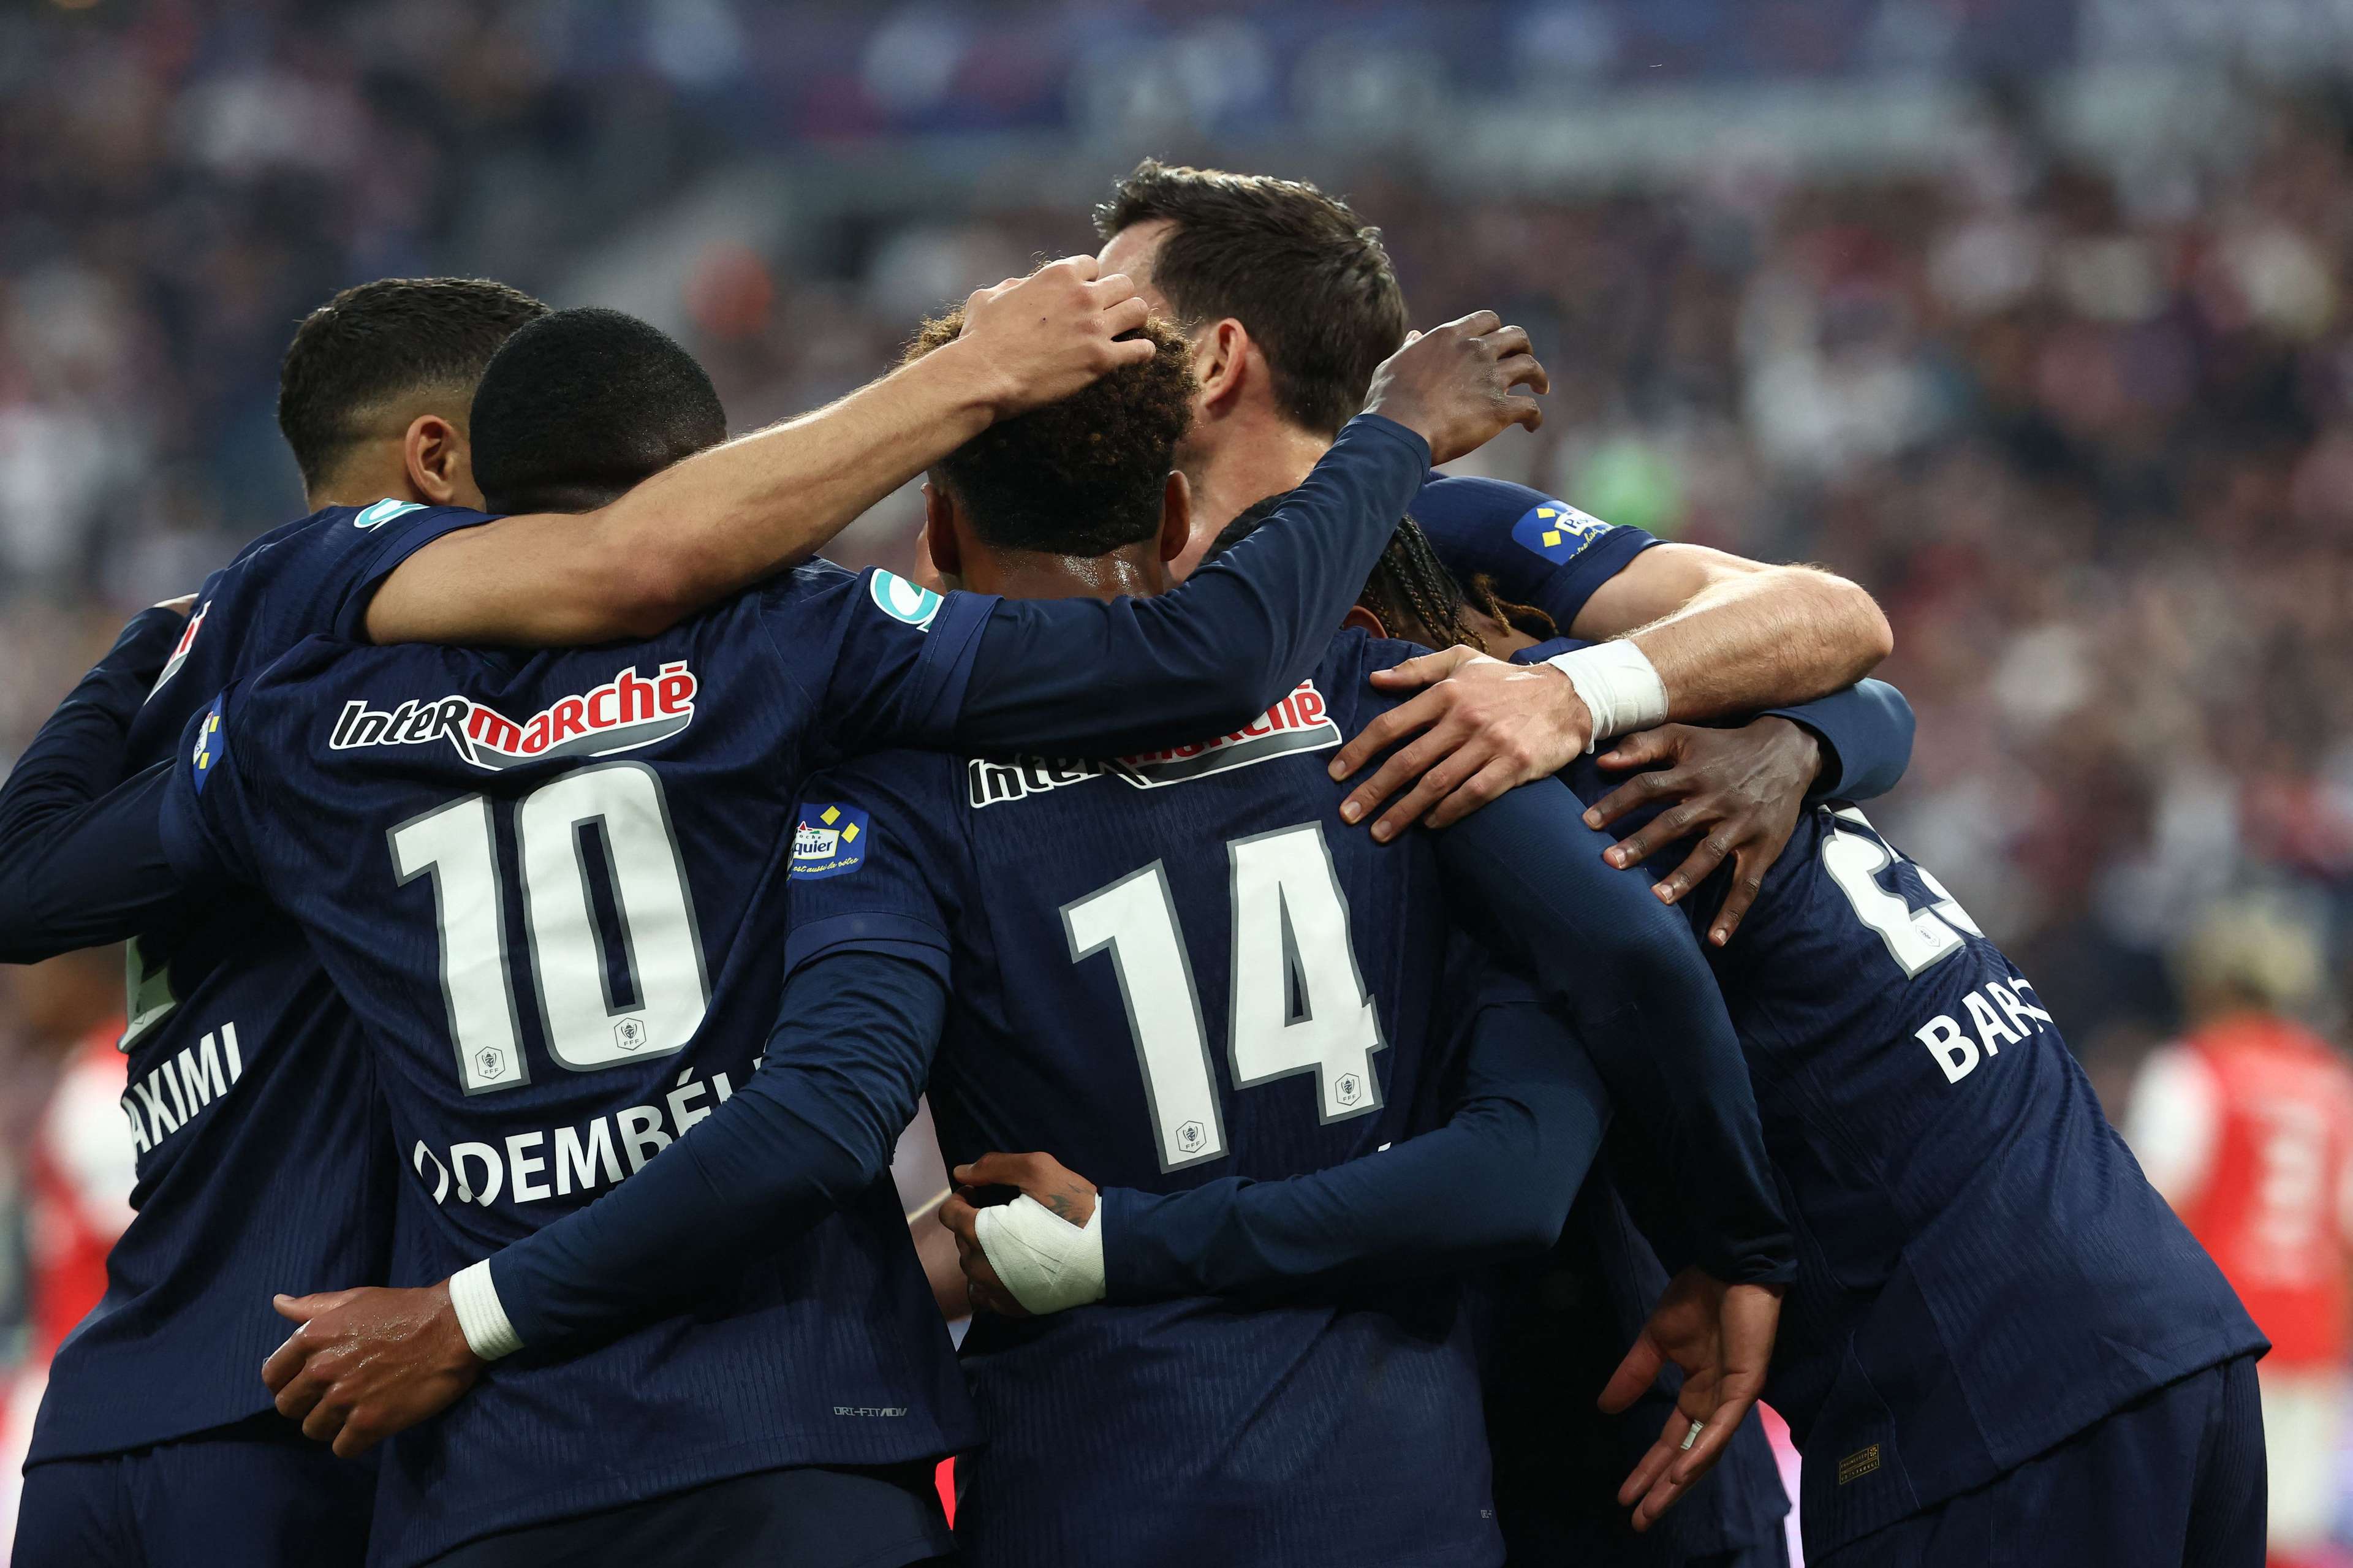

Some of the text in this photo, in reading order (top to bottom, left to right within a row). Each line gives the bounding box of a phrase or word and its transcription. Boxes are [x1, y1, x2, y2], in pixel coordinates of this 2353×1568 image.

[386, 760, 712, 1097] 10
[794, 840, 833, 855] quier
[1059, 820, 1389, 1175] 14
